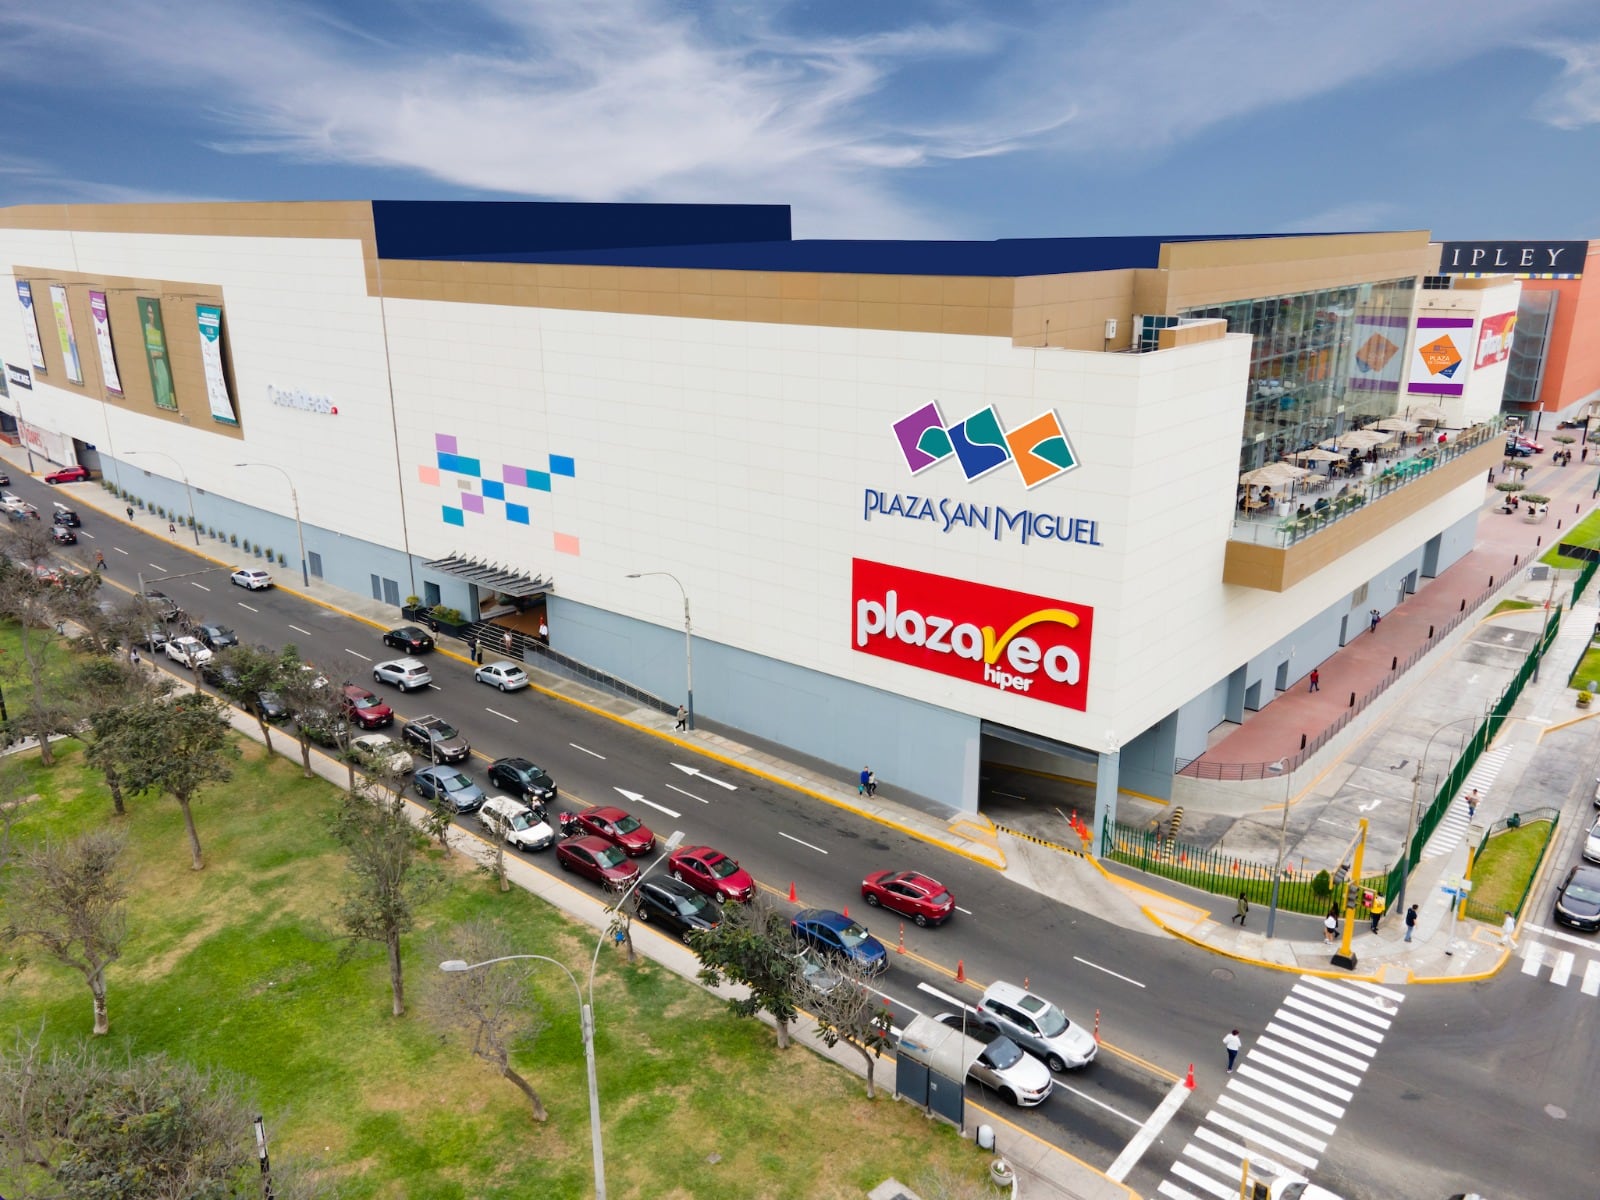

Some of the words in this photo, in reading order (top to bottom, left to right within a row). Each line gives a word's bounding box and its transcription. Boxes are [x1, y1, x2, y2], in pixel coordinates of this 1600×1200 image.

[1451, 248, 1565, 267] IPLEY
[864, 488, 936, 522] PLAZA
[939, 498, 989, 533] SAN
[994, 506, 1101, 546] MIGUEL
[984, 662, 1033, 692] hiper
